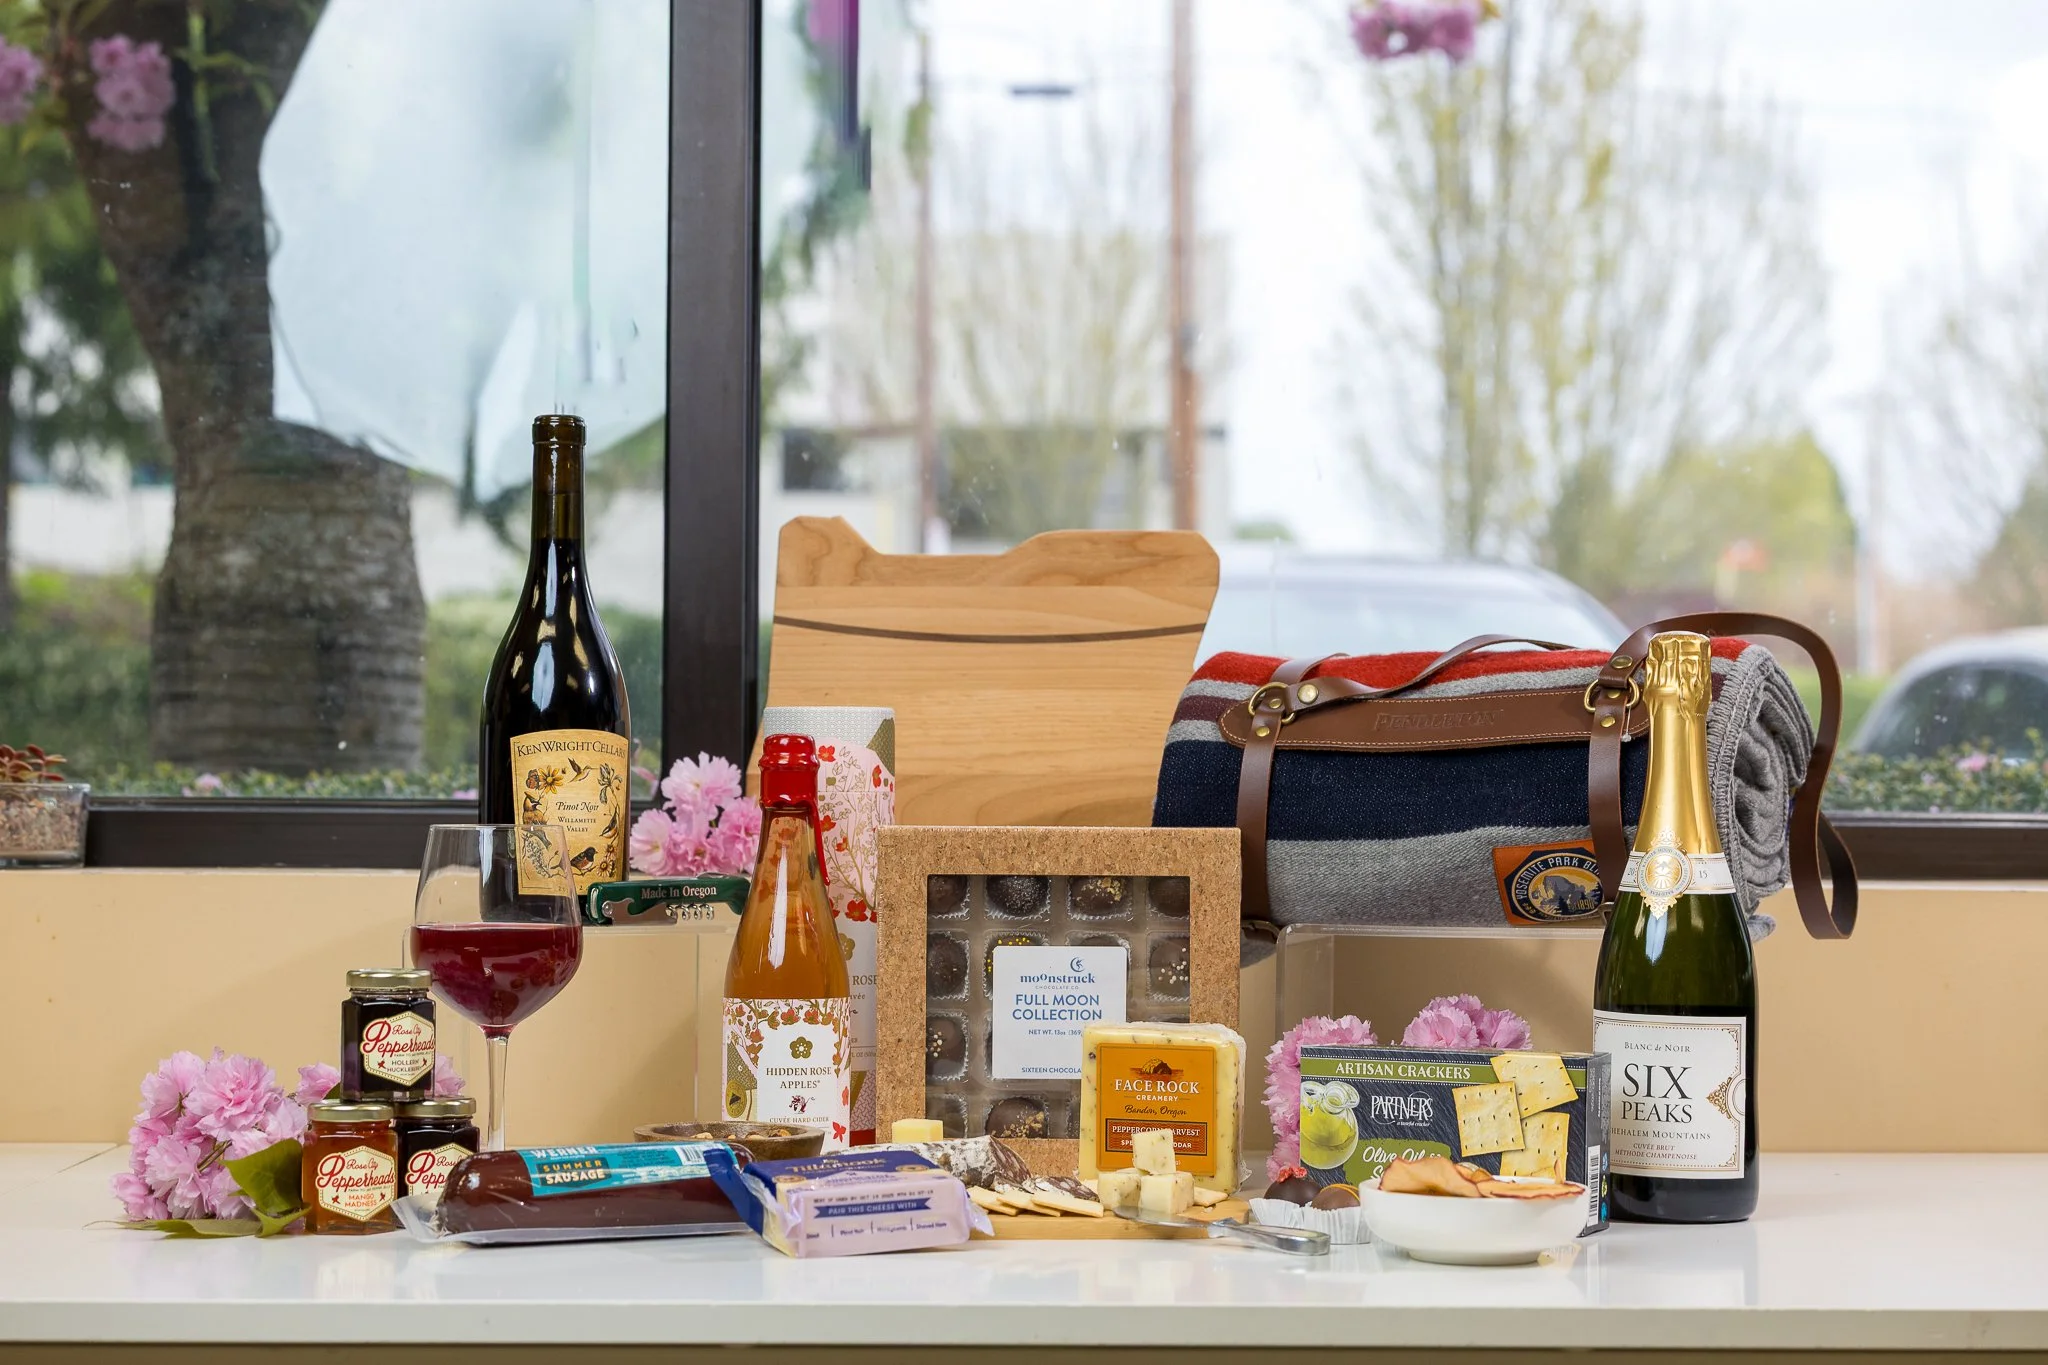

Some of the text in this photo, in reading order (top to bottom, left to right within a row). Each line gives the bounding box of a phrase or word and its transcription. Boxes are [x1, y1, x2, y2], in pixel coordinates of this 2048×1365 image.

[517, 740, 626, 759] KEN WRIGHT CELLARS
[555, 801, 600, 812] Pinot Noir
[566, 824, 589, 833] VALLEY
[1515, 860, 1546, 901] YOSEMITE
[1547, 855, 1580, 868] PARK
[1698, 870, 1708, 880] 15
[640, 885, 718, 900] Made In Oregon
[1020, 972, 1096, 984] moonstruck
[1015, 993, 1100, 1006] FULL MOON
[1012, 1008, 1103, 1021] COLLECTION
[391, 1024, 413, 1036] Rose
[362, 1019, 435, 1058] Pepperheads
[1624, 1041, 1692, 1053] BLANC de NOIR
[765, 1066, 832, 1077] HIDDEN ROSE
[1021, 1066, 1082, 1074] SIXTEEN CHOCOLA
[1335, 1061, 1472, 1080] ARTISAN CRACKERS
[1114, 1078, 1200, 1095] FACE ROCK
[1622, 1062, 1693, 1101] SIX
[1135, 1094, 1179, 1103] CREAMERY
[1124, 1103, 1188, 1119] Bandon, Oregon
[1370, 1092, 1434, 1122] PARTNERS
[1620, 1100, 1693, 1125] PEAKS
[792, 1116, 811, 1124] HARD
[1168, 1127, 1201, 1137] ARVEST
[1611, 1126, 1712, 1141] HEHALEM MOUNTAINS
[530, 1145, 599, 1159] WERNER
[1362, 1145, 1398, 1164] Olive
[1655, 1144, 1676, 1152] BRUT
[346, 1158, 367, 1170] Rose
[543, 1159, 603, 1173] SUMMER
[317, 1153, 395, 1193] Pepperheads
[545, 1169, 606, 1185] SAUSAGE
[344, 1199, 378, 1208] MADNESS
[348, 1193, 375, 1201] MANGO
[828, 1201, 918, 1216] PAIR THIS CHEESE WITH
